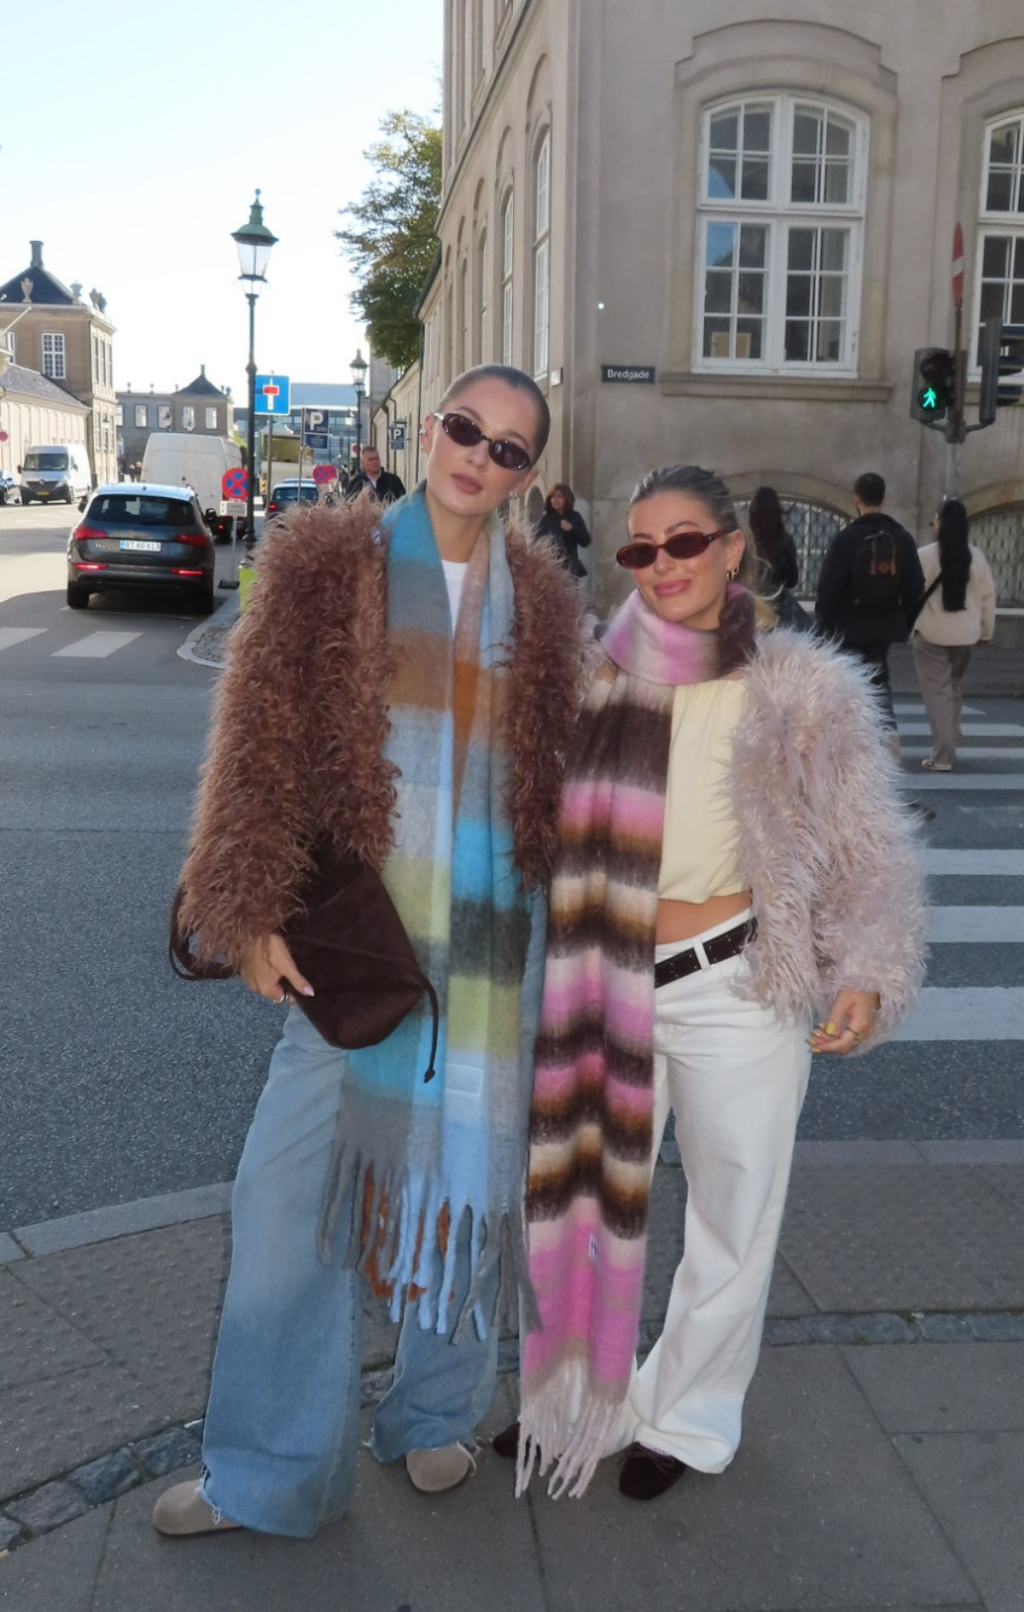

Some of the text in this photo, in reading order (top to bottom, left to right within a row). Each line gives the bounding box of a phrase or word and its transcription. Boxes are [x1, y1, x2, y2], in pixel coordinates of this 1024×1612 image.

[607, 368, 649, 380] Bredgade
[310, 411, 323, 430] P
[393, 429, 401, 440] P
